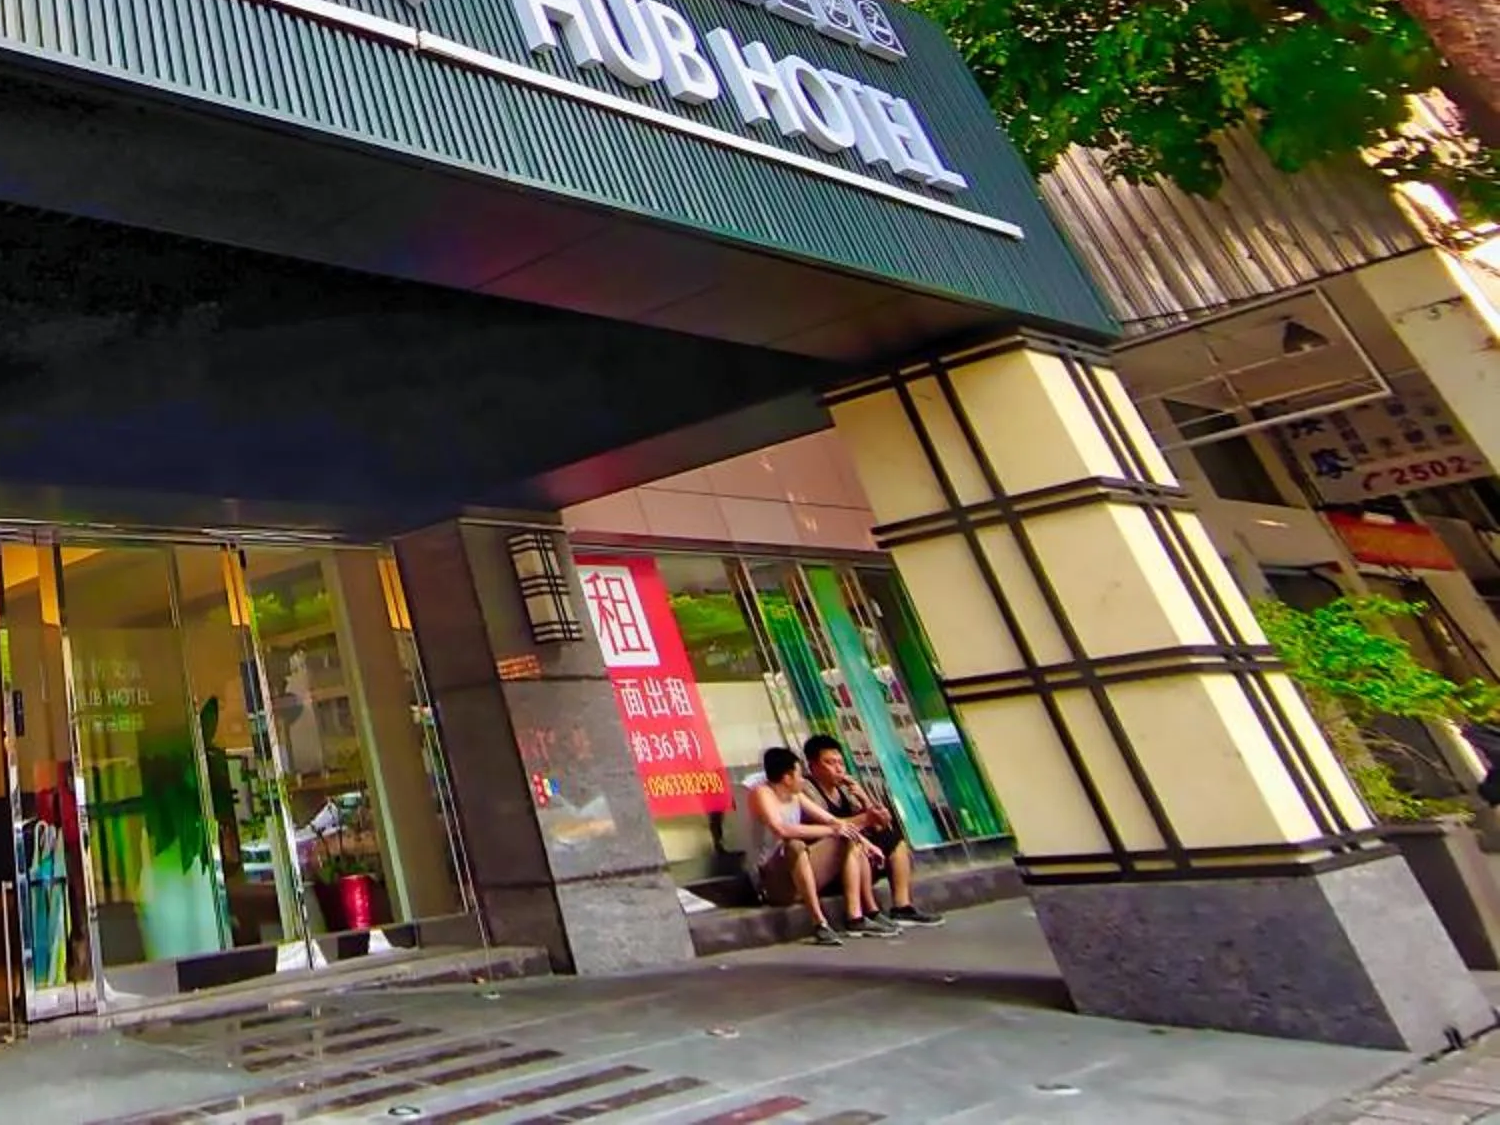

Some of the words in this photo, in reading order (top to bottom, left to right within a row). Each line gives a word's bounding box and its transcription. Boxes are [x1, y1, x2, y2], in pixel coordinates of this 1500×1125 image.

[707, 26, 969, 194] HOTEL
[583, 570, 652, 656] 租
[106, 687, 155, 707] HOTEL
